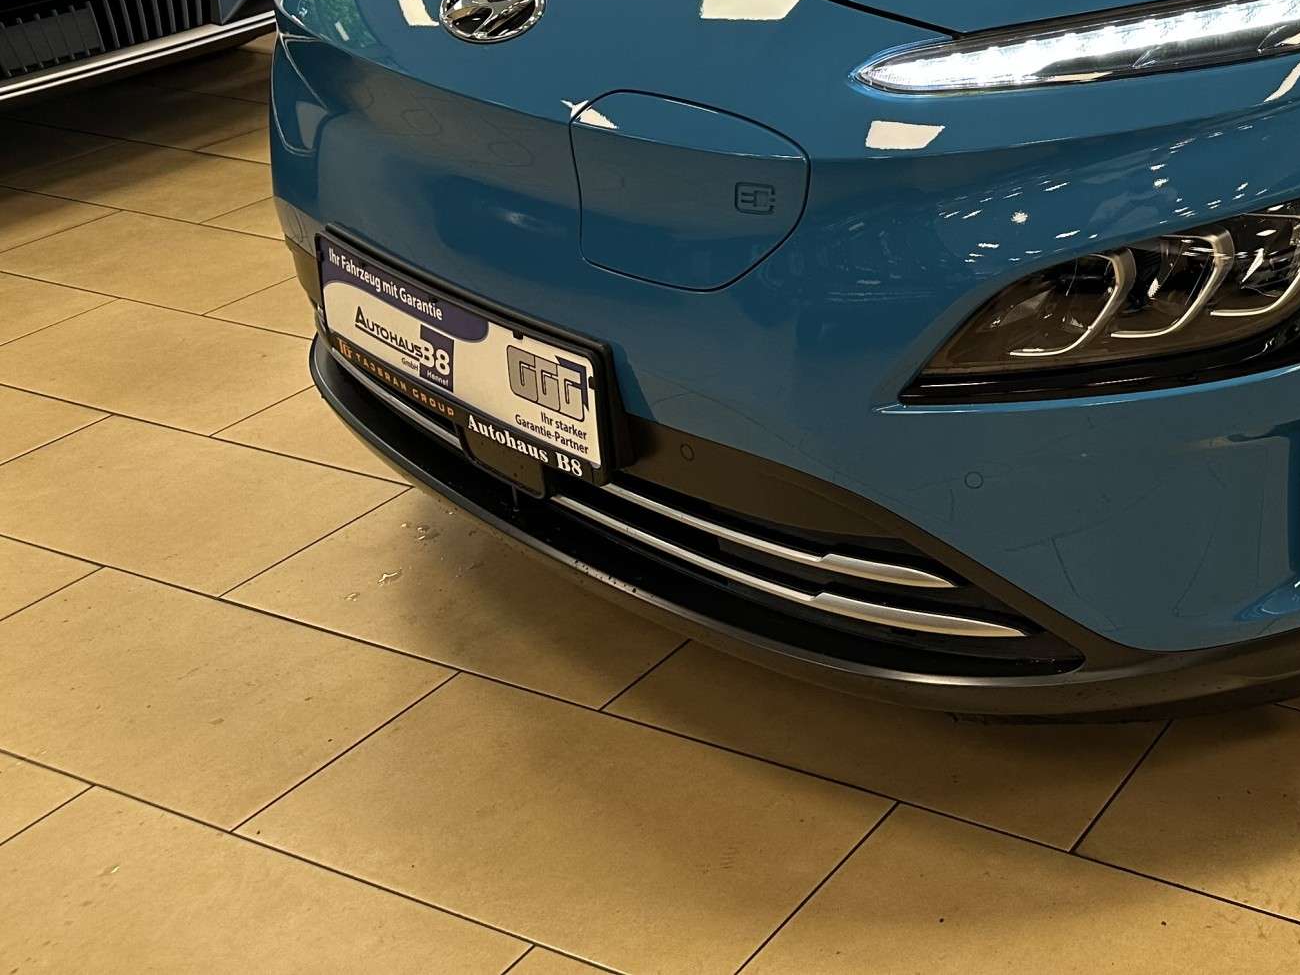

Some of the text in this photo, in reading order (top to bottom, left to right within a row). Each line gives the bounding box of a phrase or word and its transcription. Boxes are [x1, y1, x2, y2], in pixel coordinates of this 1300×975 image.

[329, 247, 443, 321] Ihr Fahrzeug mit Garantie
[355, 306, 424, 359] AUTOHAUS
[402, 357, 450, 387] GmbH Hennef
[412, 387, 455, 417] GROUP
[468, 414, 583, 477] Autohaus B8
[515, 414, 589, 455] Garantie-Partner
[541, 411, 587, 441] Ihr starker
